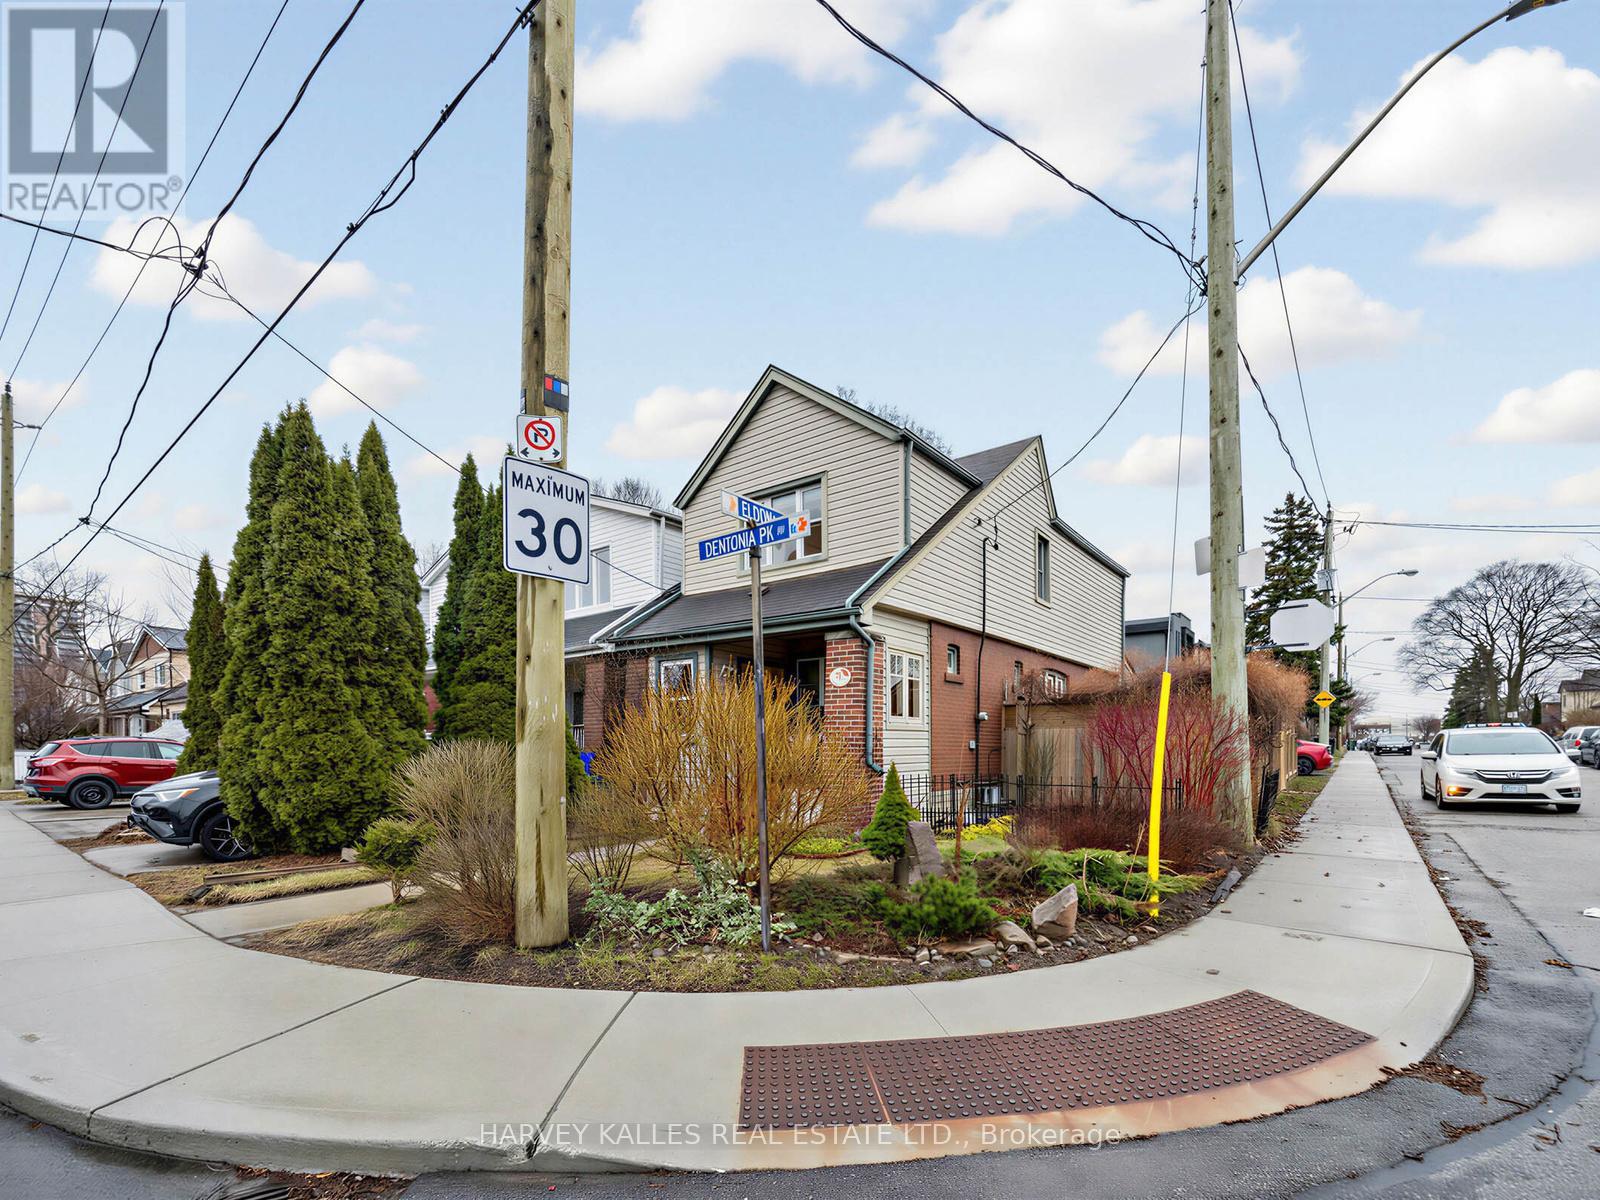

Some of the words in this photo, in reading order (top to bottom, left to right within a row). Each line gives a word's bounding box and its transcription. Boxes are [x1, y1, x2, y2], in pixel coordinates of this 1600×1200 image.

[512, 471, 585, 506] MAXIMUM
[742, 501, 776, 524] ELDON
[515, 508, 582, 565] 30
[705, 530, 757, 557] DENTONIA
[760, 524, 774, 544] PK
